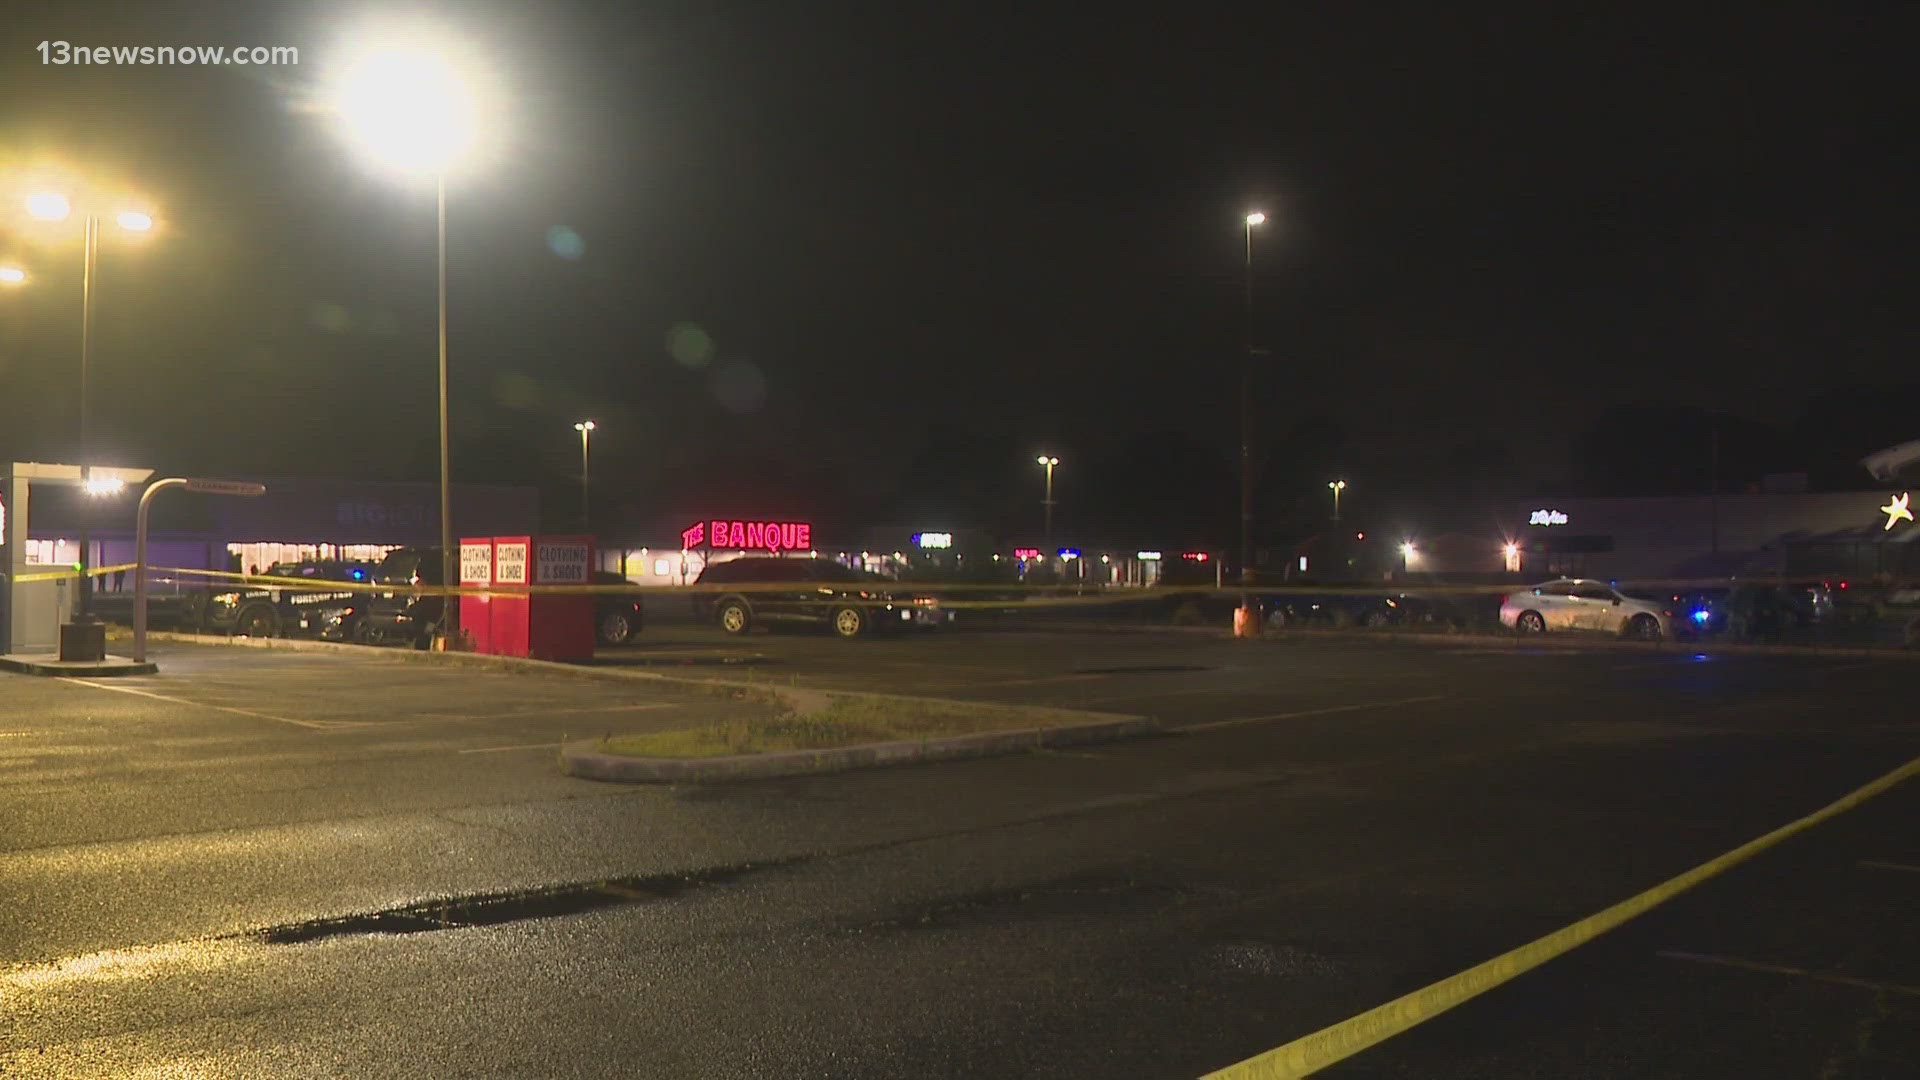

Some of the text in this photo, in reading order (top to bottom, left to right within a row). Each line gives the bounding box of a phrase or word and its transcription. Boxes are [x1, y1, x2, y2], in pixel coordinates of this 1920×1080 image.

[682, 521, 810, 552] THE BANQUE
[462, 548, 490, 562] CLOTHING
[498, 547, 525, 562] CLOTHING
[539, 546, 586, 562] CLOTHING
[464, 565, 488, 579] & SHOES
[500, 565, 522, 579] & SHOES
[553, 565, 582, 579] SHOES
